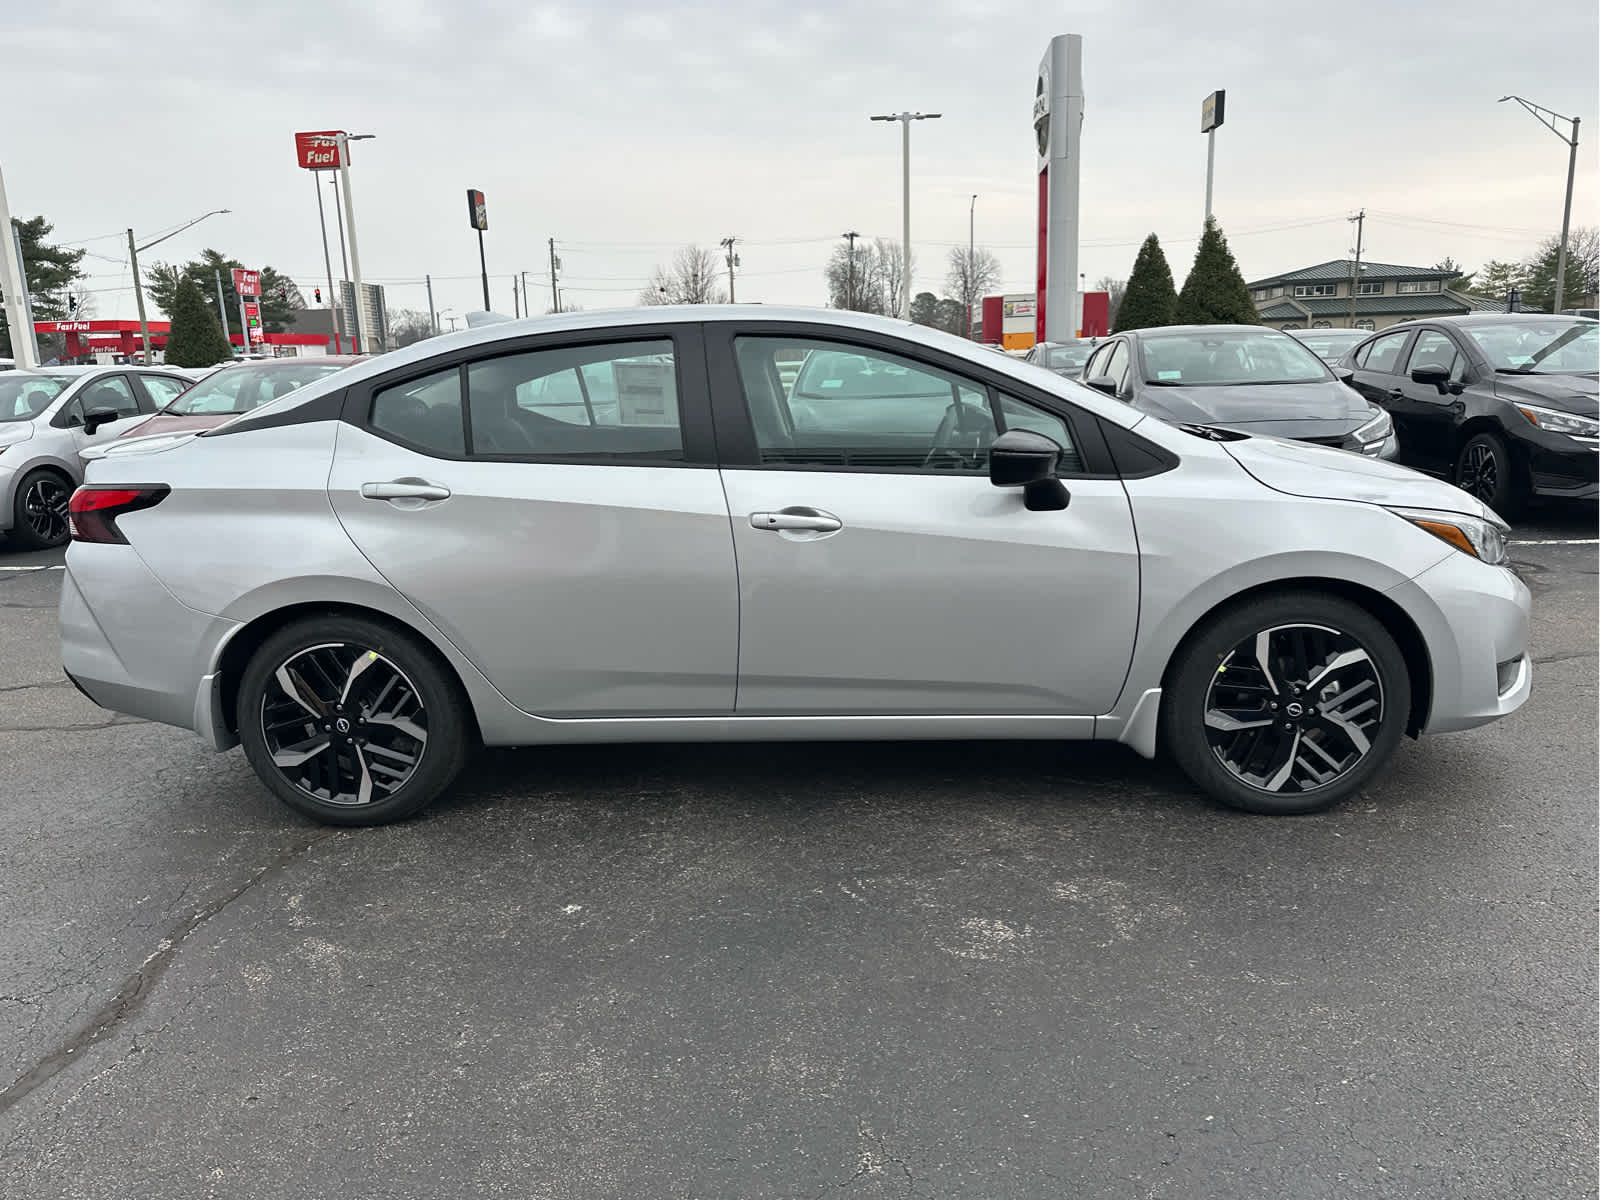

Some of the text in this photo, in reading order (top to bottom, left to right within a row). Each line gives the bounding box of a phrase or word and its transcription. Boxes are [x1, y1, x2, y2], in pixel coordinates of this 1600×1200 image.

[313, 135, 337, 147] Fas
[307, 149, 335, 163] Fuel
[240, 282, 255, 294] Fuel
[56, 321, 90, 331] Fast Fuel
